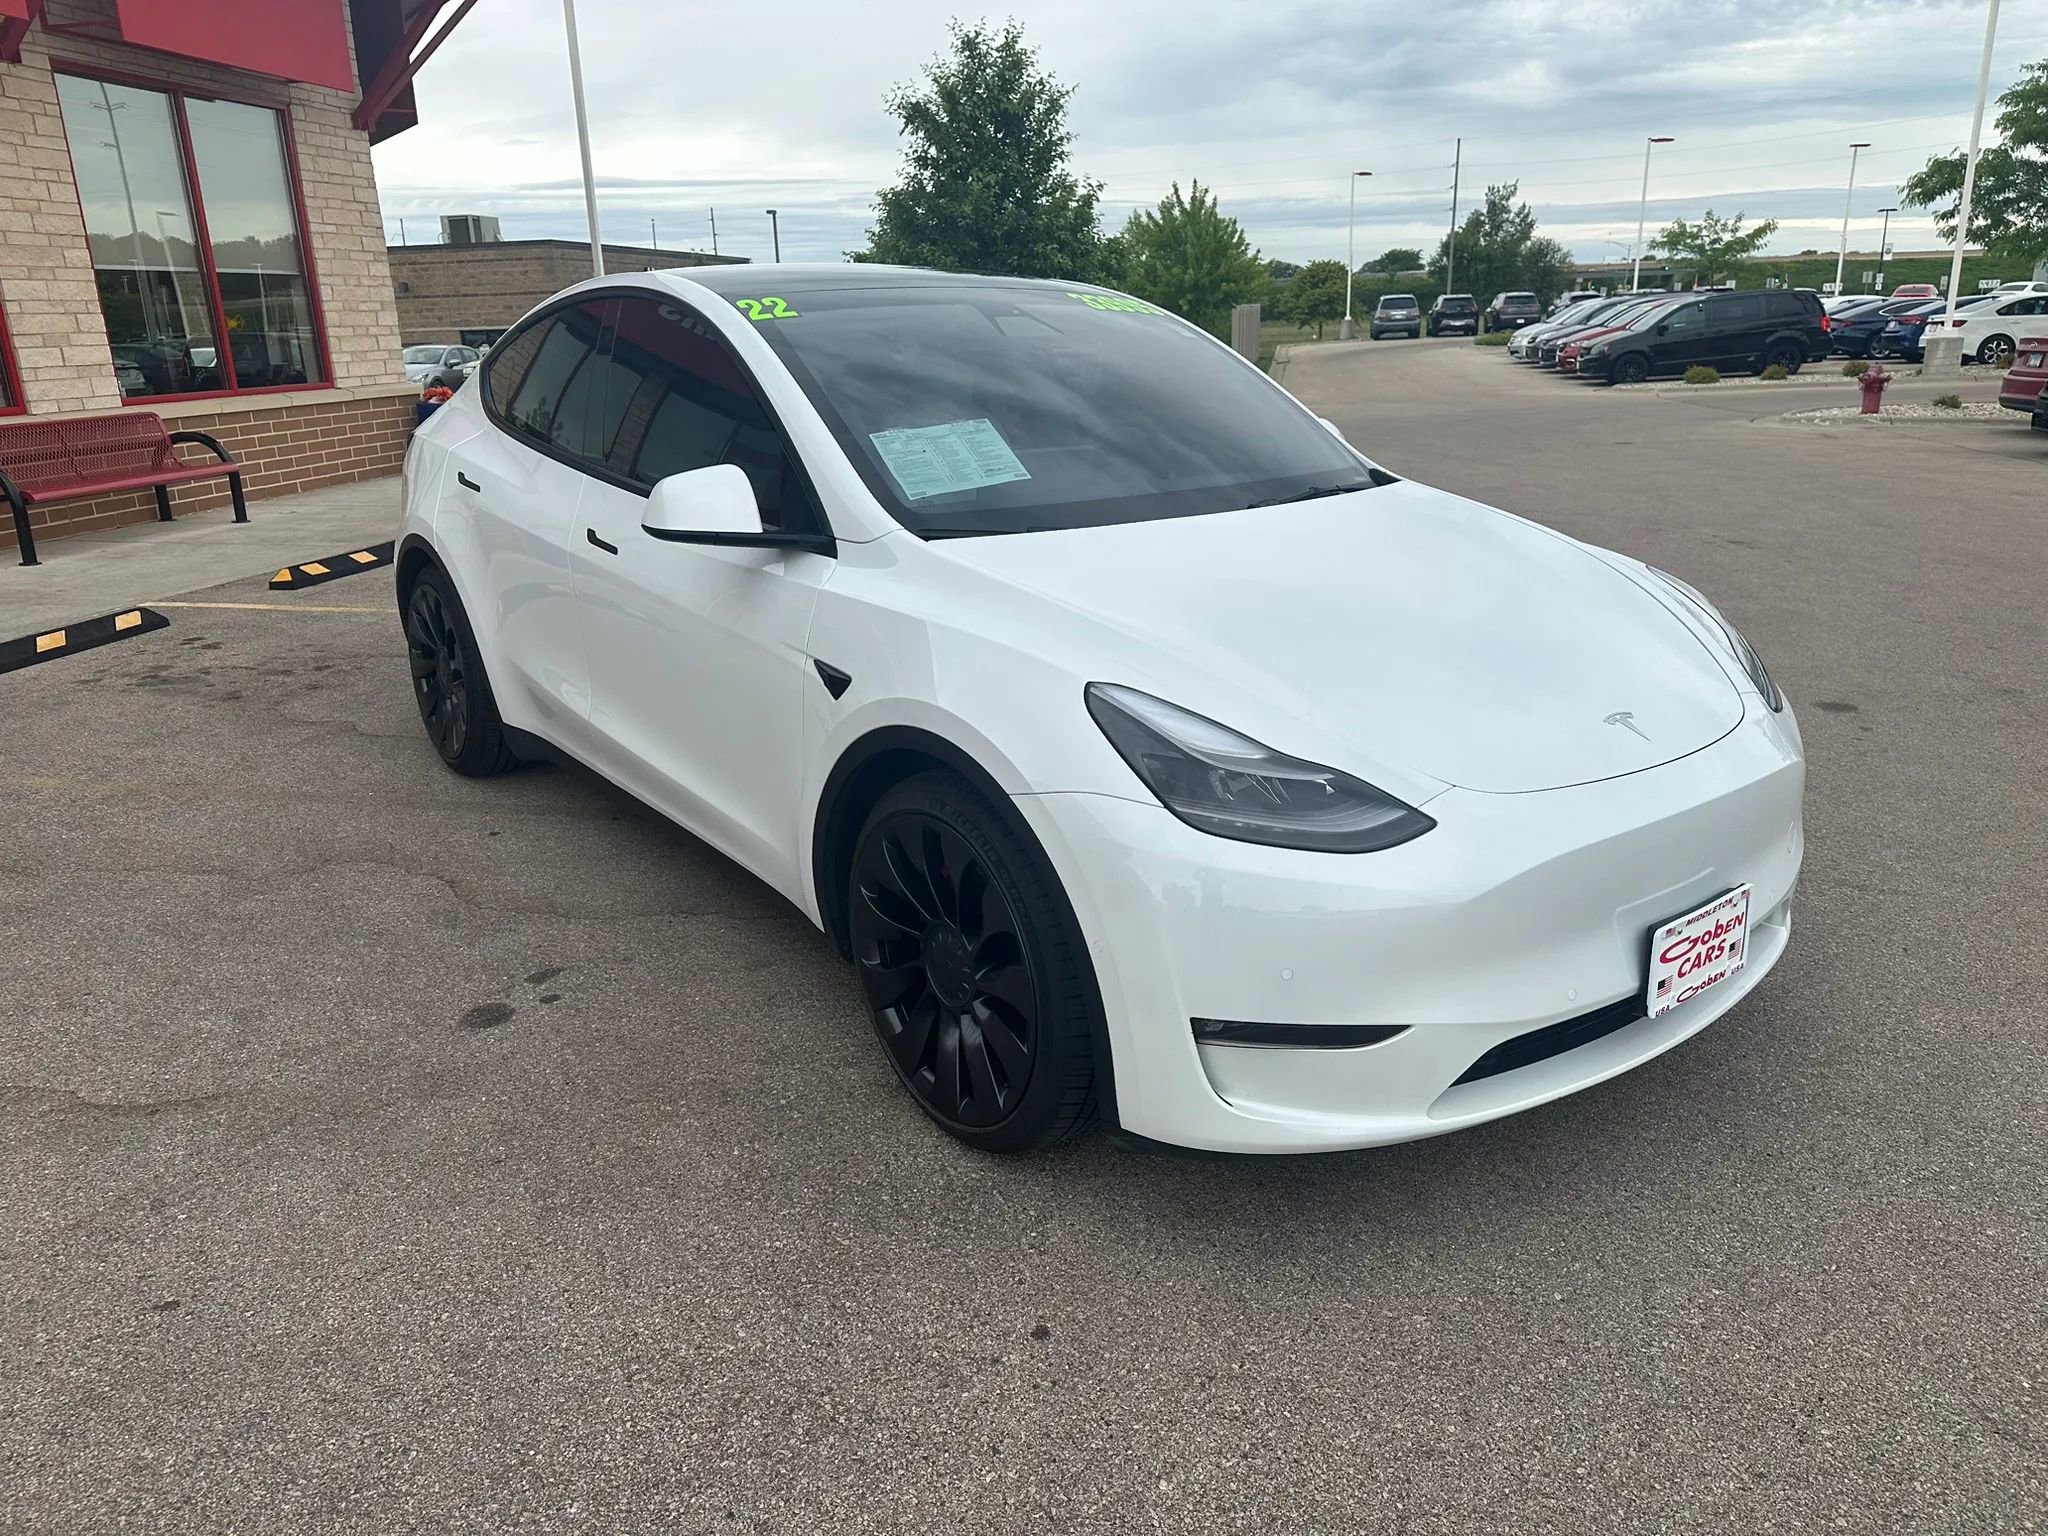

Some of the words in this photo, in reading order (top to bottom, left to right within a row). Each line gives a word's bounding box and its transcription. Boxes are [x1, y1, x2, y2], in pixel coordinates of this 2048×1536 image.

[736, 296, 799, 321] 22
[1685, 896, 1734, 927] MIDDLETON
[1677, 938, 1727, 979] CARS
[1730, 963, 1744, 976] USA
[1655, 1004, 1670, 1017] USA
